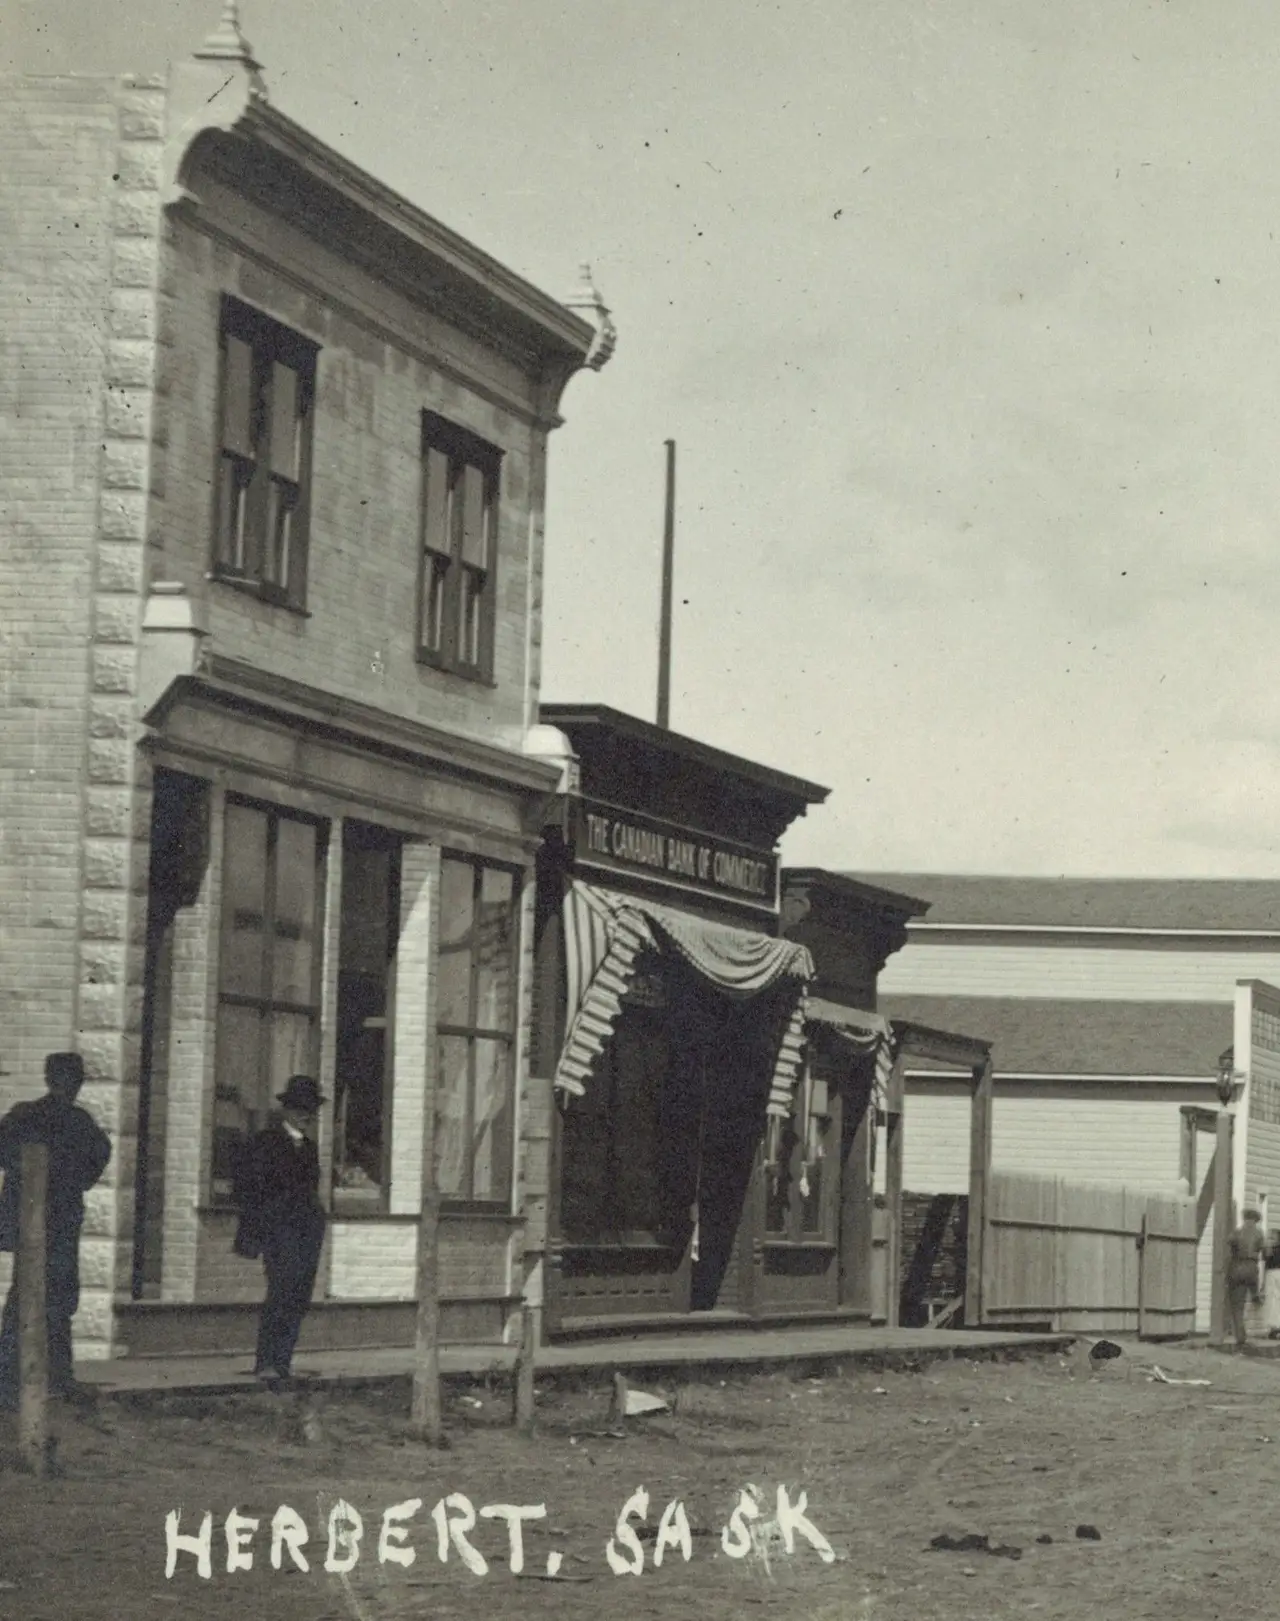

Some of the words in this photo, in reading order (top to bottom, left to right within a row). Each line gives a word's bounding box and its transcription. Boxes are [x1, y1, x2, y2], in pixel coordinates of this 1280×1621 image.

[587, 813, 609, 853] THE
[612, 821, 666, 869] CANADIAN
[667, 837, 697, 876] BANK
[698, 845, 711, 880] OF
